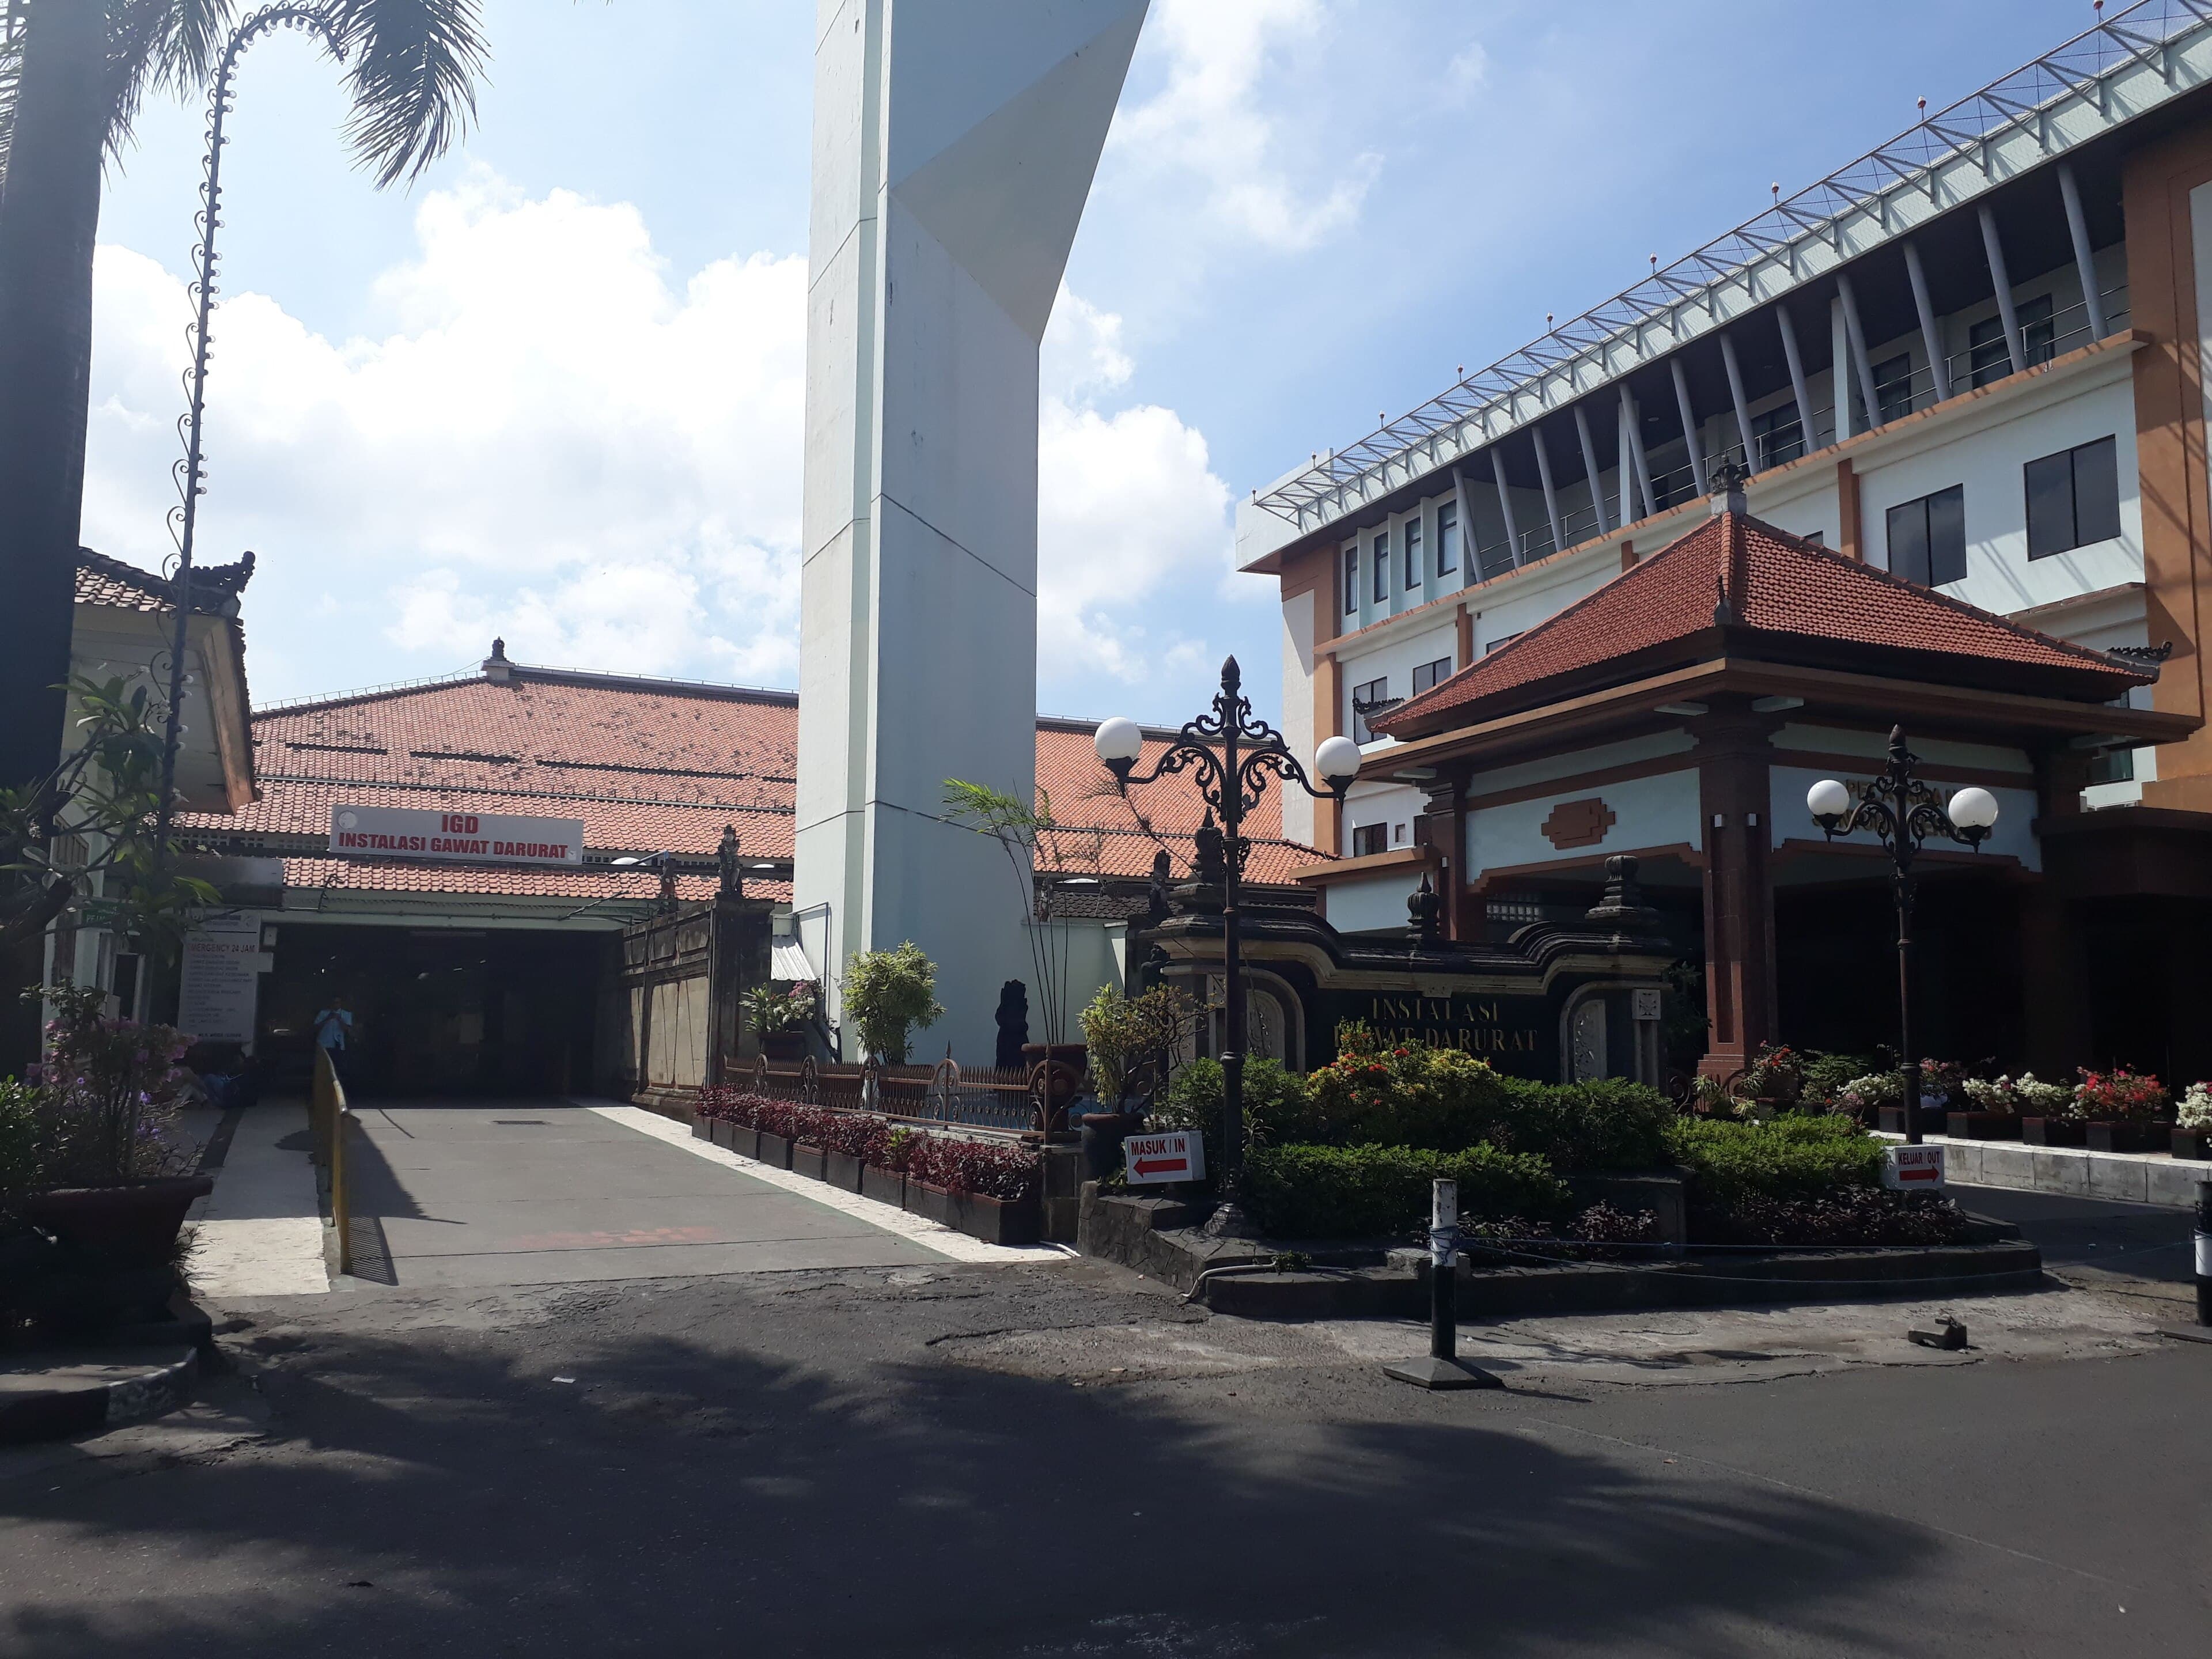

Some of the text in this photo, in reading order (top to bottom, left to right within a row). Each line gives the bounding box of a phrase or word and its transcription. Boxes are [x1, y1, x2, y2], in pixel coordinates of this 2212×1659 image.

[442, 815, 478, 834] IGD
[339, 832, 568, 858] INSTALASI GAWAT DARURAT
[1373, 998, 1497, 1021] INSTALASI
[1425, 1028, 1537, 1051] DARURAT
[1131, 1139, 1166, 1156] MASUK
[1175, 1138, 1185, 1153] IN
[1898, 1152, 1940, 1165] KELUAR OUT
